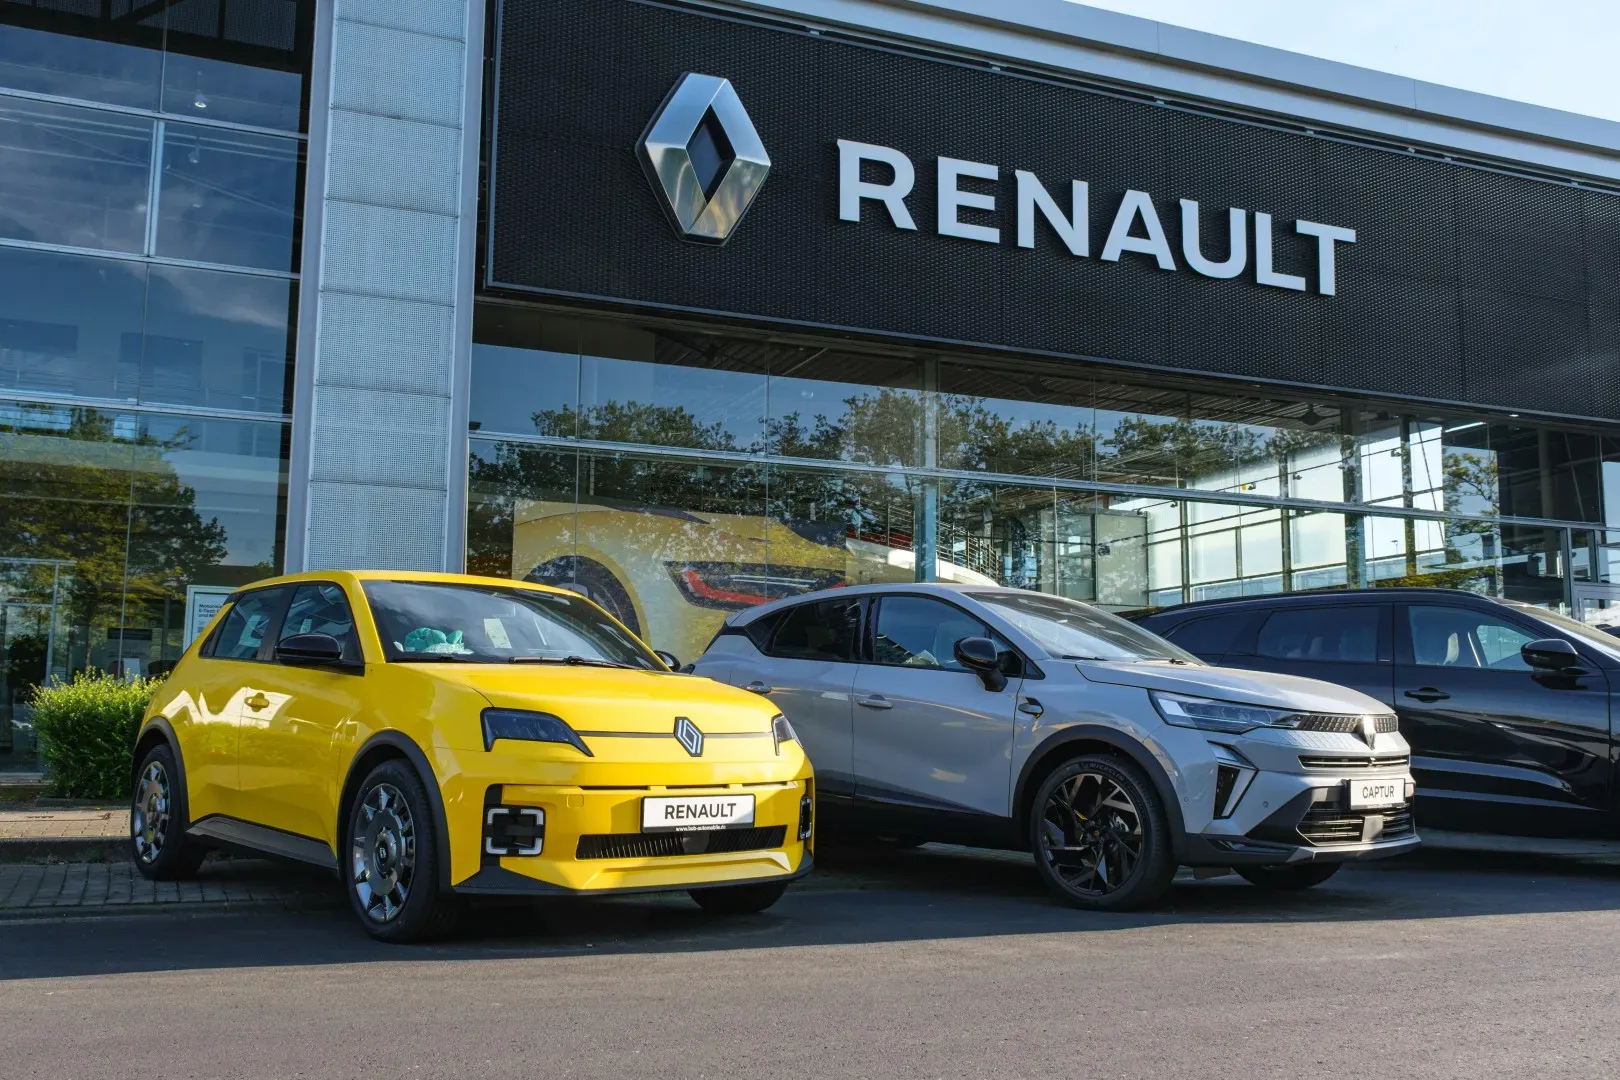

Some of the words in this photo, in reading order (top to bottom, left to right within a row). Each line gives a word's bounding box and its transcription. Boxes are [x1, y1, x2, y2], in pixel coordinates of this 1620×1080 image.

[837, 138, 1356, 296] RENAULT
[1362, 785, 1395, 799] CAPTUR
[664, 803, 737, 820] RENAULT
